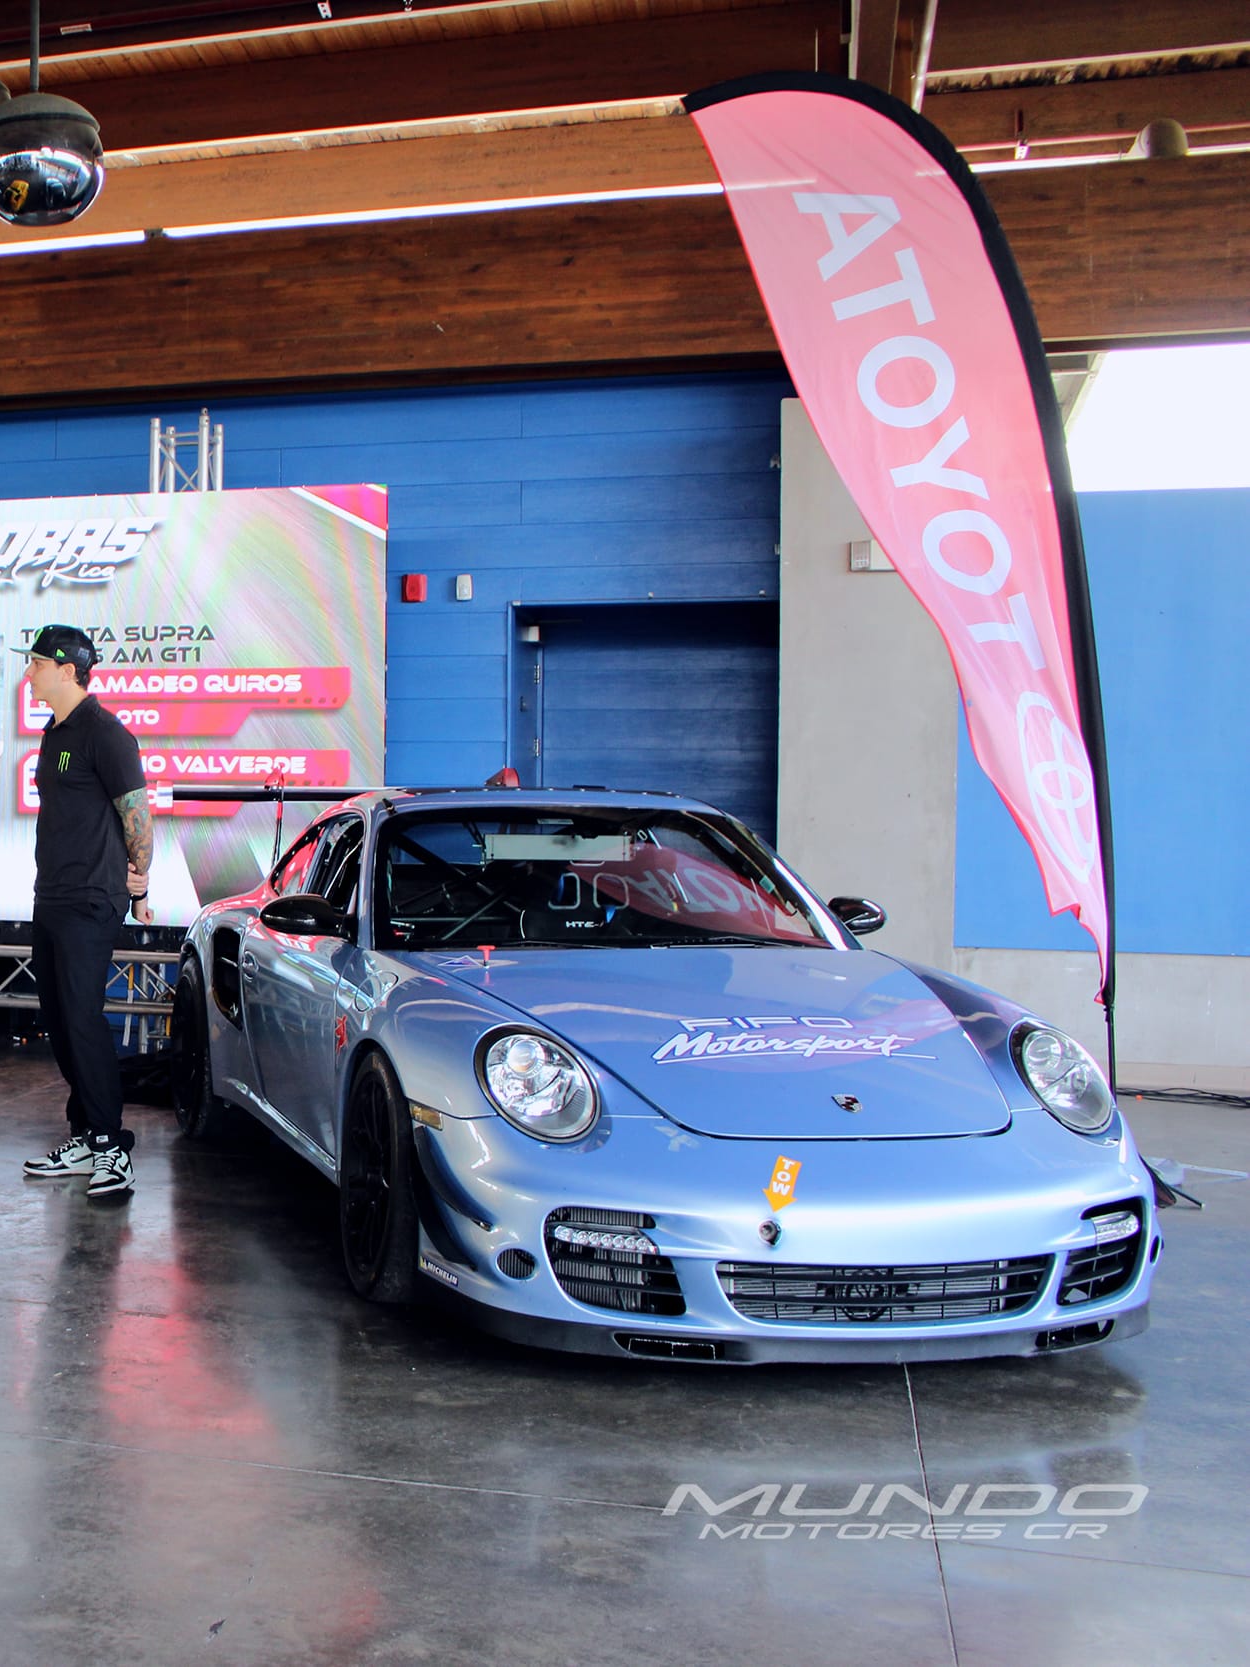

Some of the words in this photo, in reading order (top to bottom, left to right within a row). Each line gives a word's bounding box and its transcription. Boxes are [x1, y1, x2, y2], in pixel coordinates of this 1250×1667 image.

[12, 553, 117, 588] Rica
[21, 627, 116, 643] TTA
[124, 625, 215, 641] SUPRA
[110, 648, 153, 663] AM
[161, 647, 202, 663] GT1
[88, 675, 198, 693] AMADEO
[204, 674, 303, 693] QUIROS
[175, 755, 307, 774] VALVERDE
[679, 1016, 854, 1031] FIFO
[651, 1031, 915, 1060] Motorsport
[772, 1158, 797, 1196] TOW
[428, 1262, 458, 1285] MICHELIN
